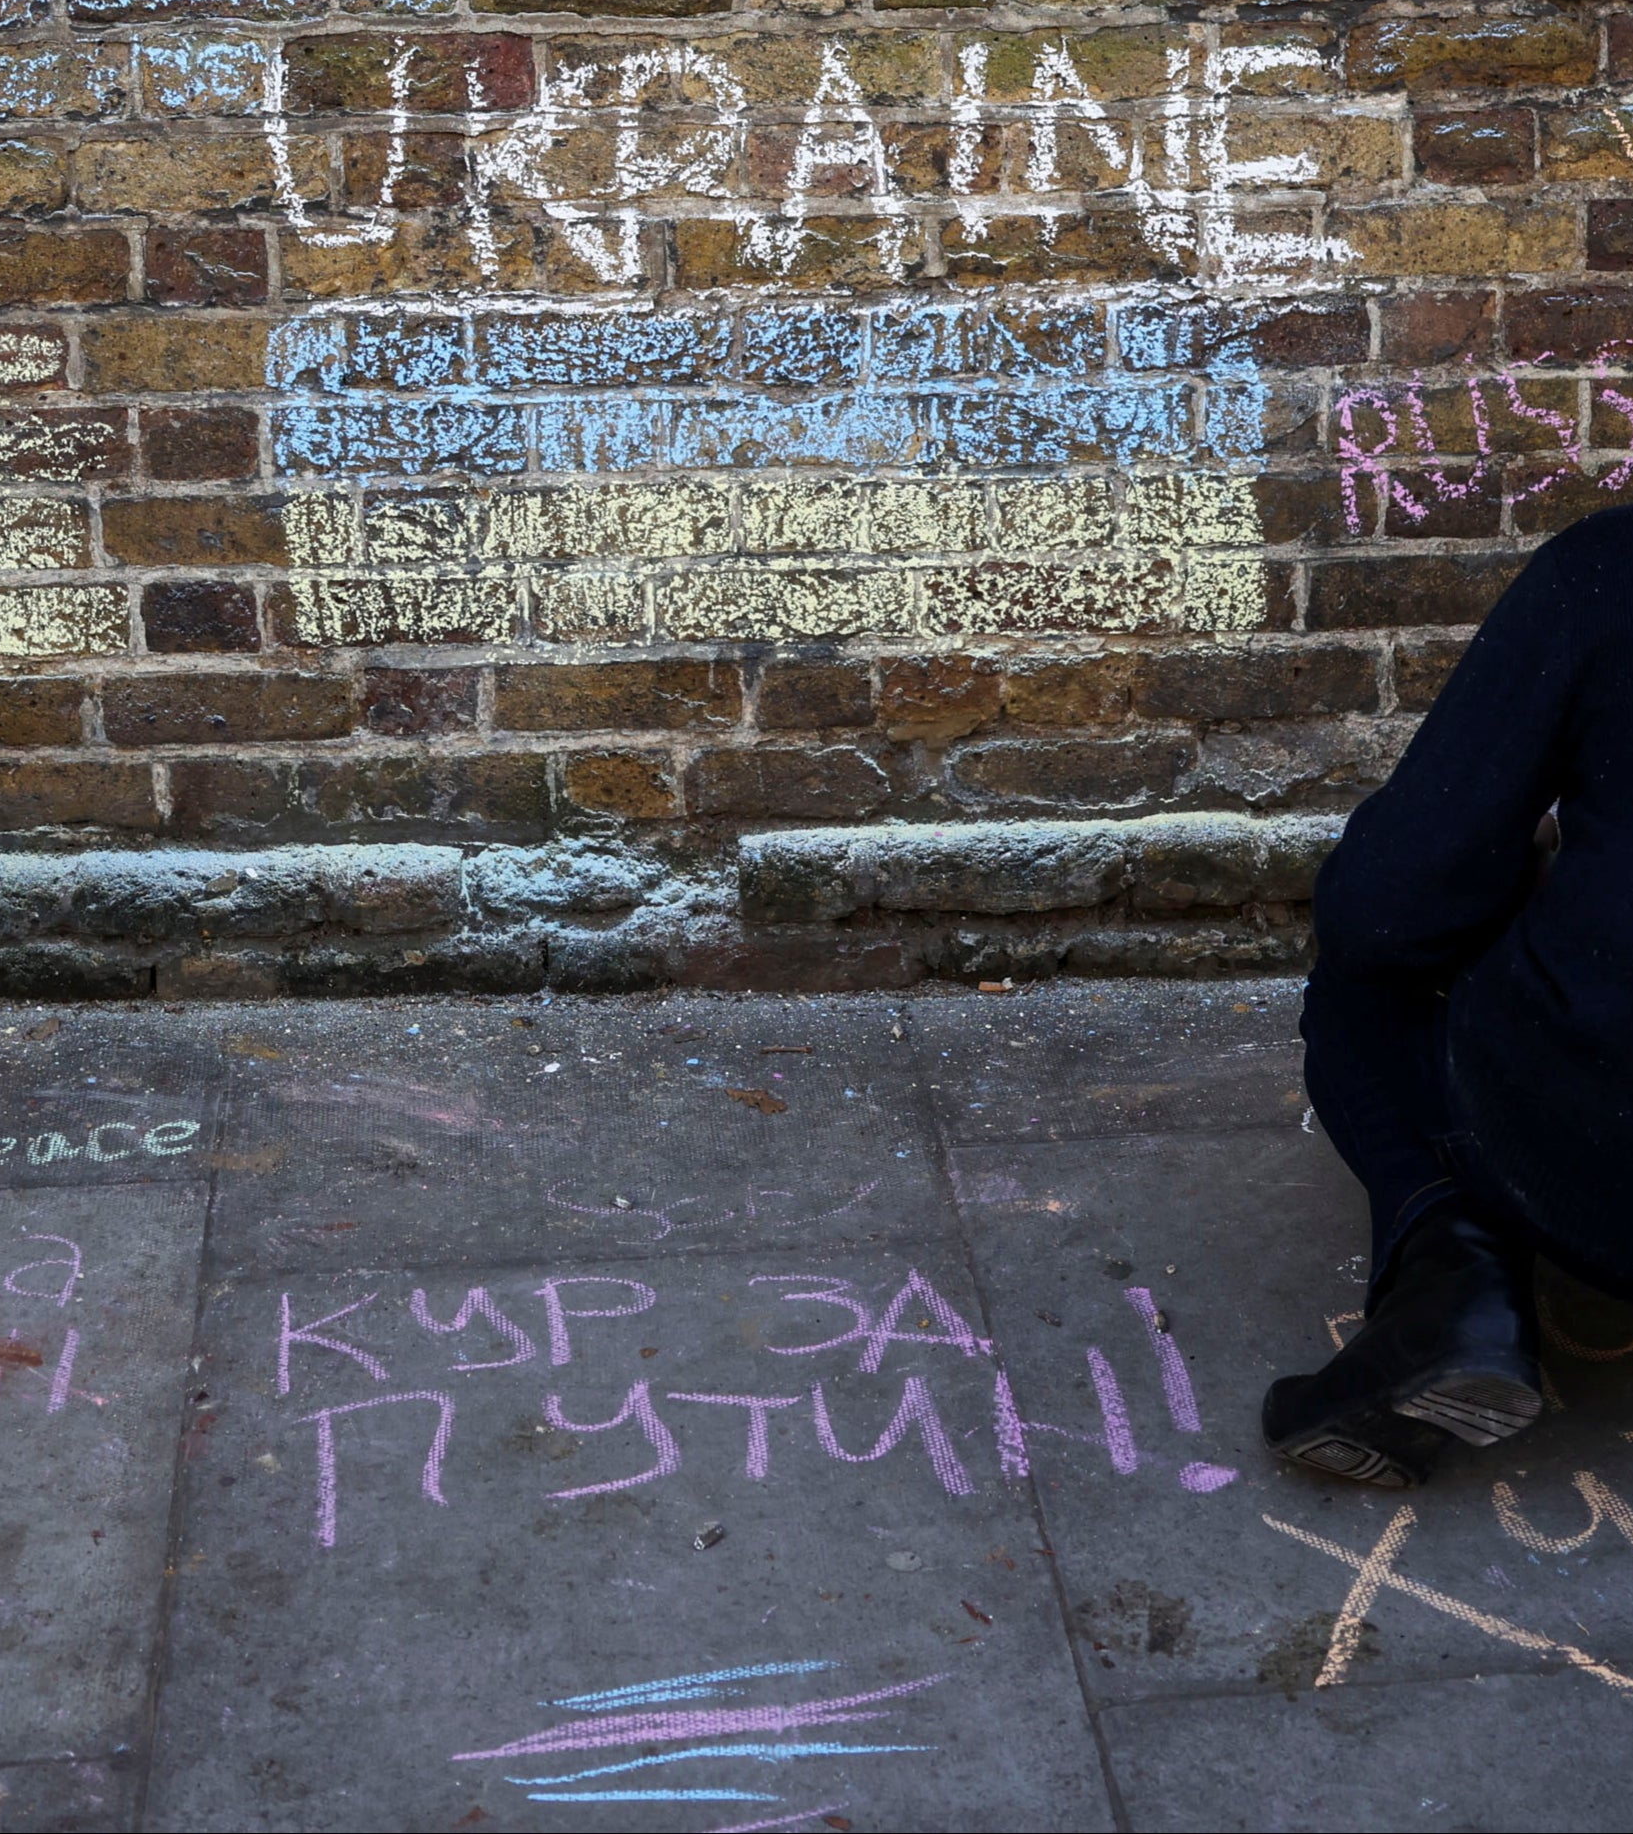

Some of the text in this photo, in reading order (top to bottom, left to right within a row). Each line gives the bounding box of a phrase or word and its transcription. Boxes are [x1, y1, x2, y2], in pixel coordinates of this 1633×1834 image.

[261, 18, 1365, 290] UKRAINE
[277, 1266, 995, 1395] КУР ЗА
